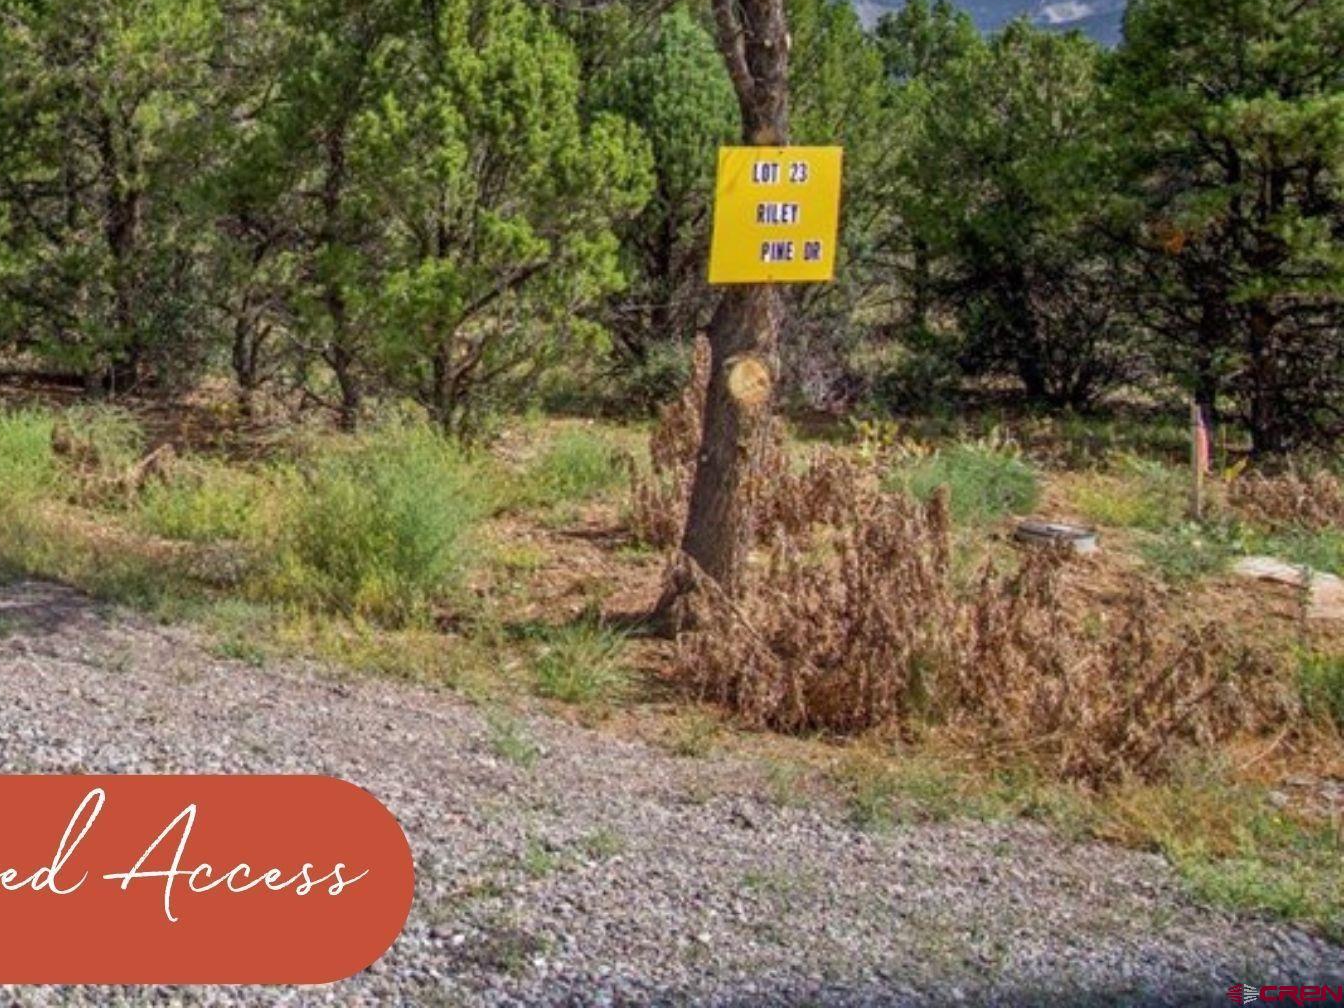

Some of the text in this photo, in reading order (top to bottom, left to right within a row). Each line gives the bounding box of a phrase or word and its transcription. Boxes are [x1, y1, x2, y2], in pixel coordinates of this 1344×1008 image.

[752, 162, 808, 183] LOT 23
[756, 203, 799, 223] RILEY
[760, 241, 821, 261] PINE DR
